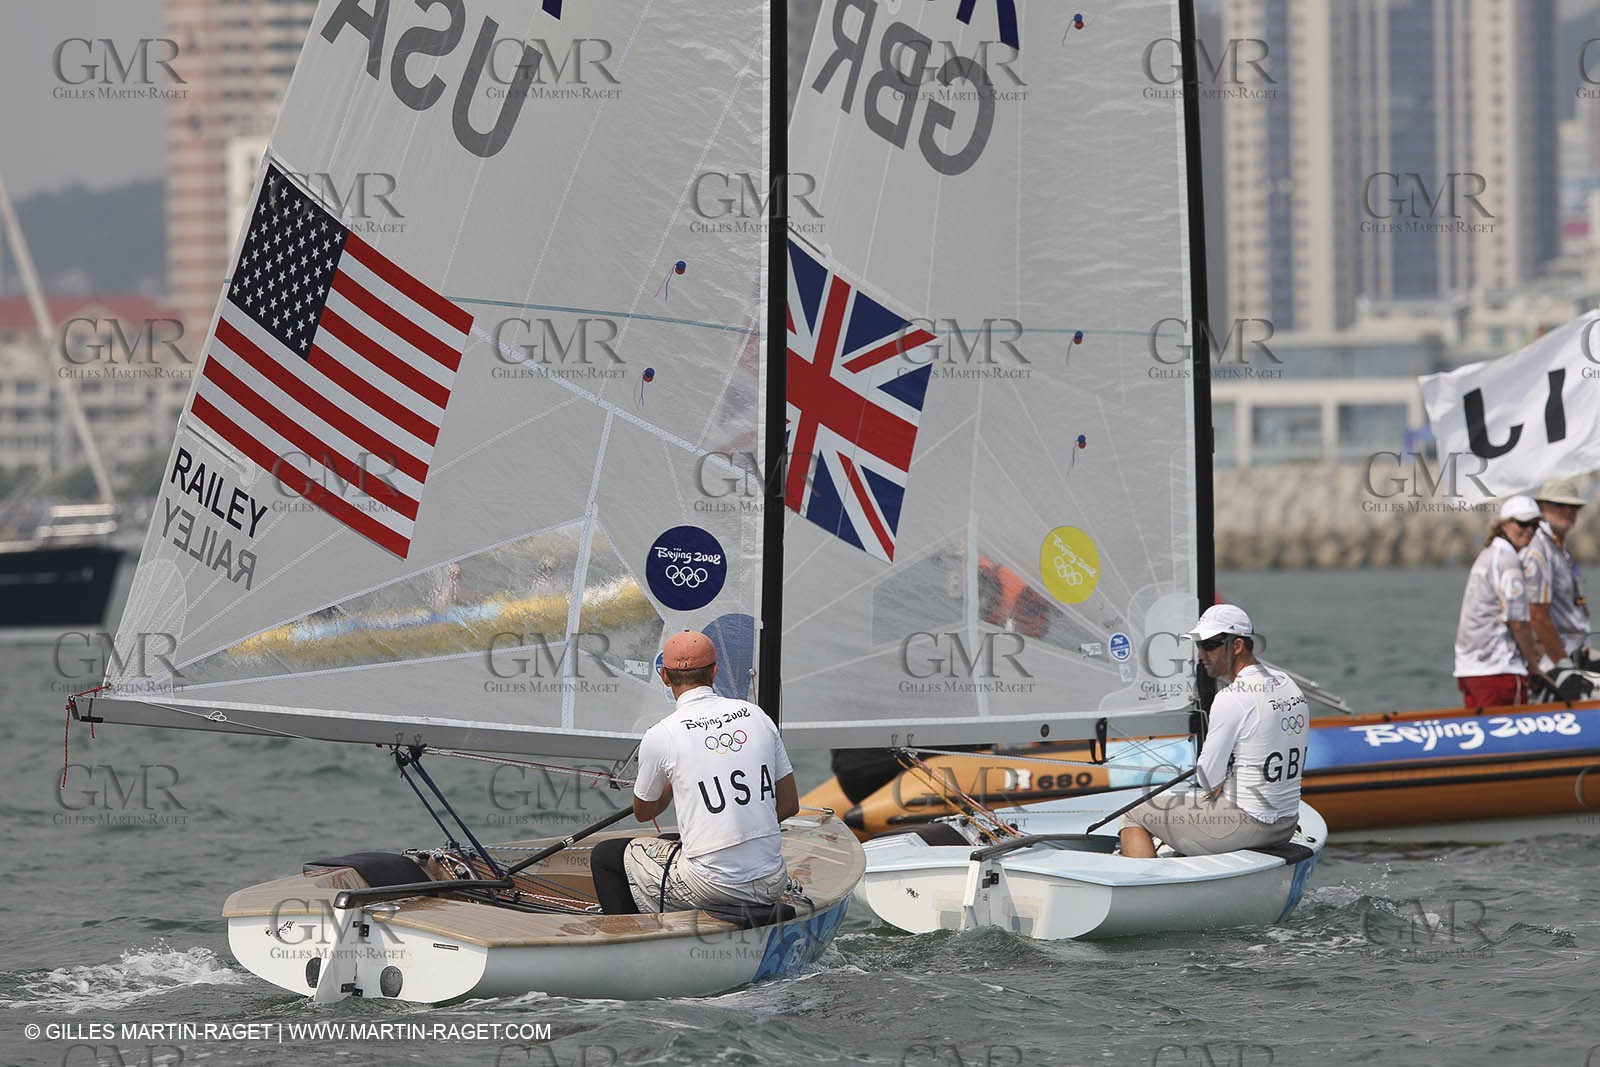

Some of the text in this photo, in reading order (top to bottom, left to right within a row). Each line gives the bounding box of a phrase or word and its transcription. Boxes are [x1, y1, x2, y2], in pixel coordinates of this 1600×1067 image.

[171, 447, 268, 538] RAILEY
[654, 547, 721, 565] Beijing 2008
[680, 707, 751, 731] Beijing 2008
[1349, 712, 1581, 751] Beijing 2008
[698, 764, 775, 814] USA
[1038, 772, 1092, 790] 680
